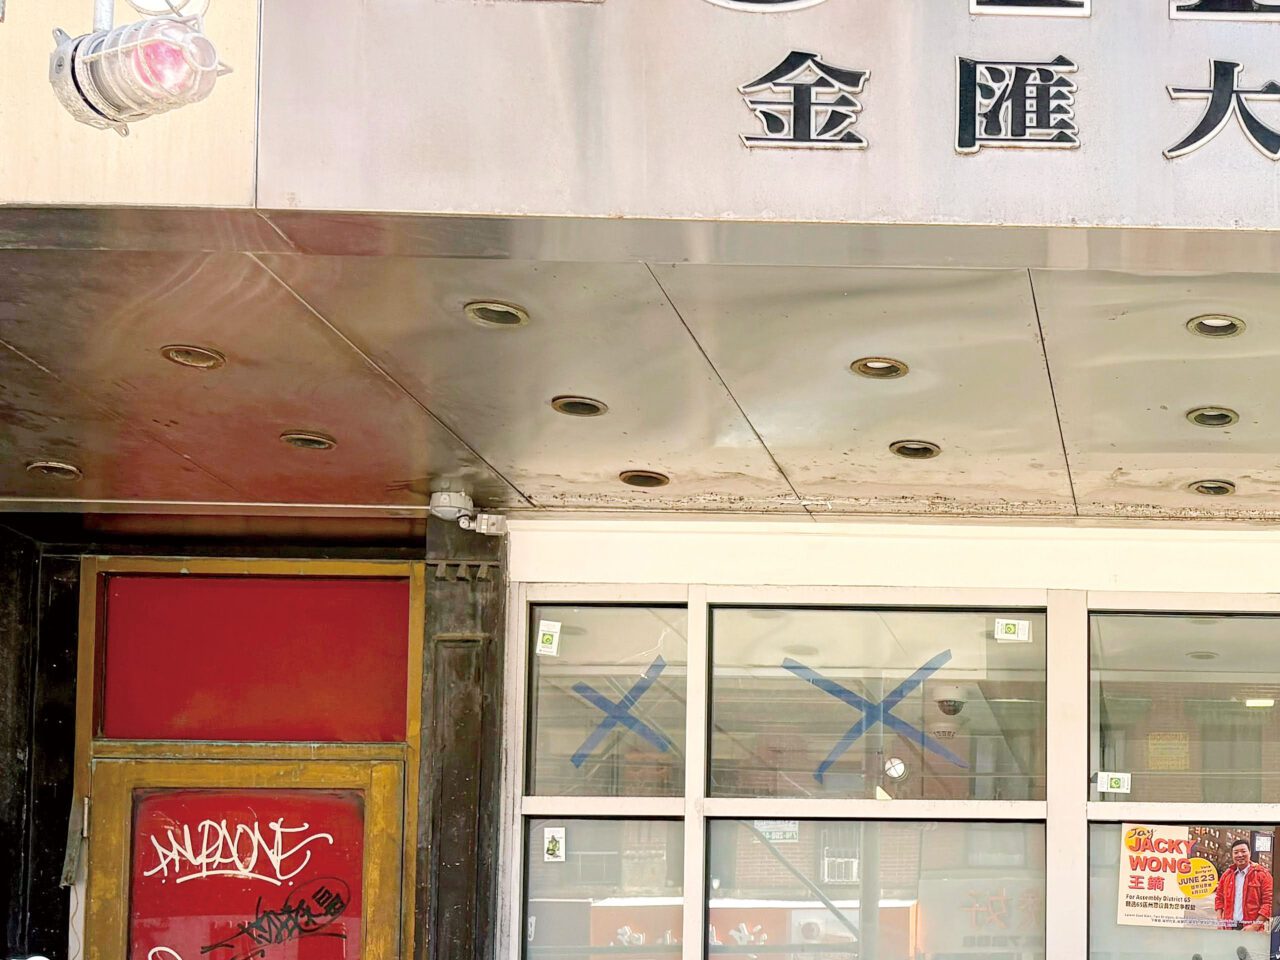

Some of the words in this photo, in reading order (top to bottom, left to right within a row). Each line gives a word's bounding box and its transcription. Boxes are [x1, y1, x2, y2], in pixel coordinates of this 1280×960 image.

[1128, 828, 1154, 840] Jay
[1128, 837, 1198, 855] JACKY
[1129, 855, 1192, 874] WONG
[1178, 876, 1199, 886] JUNE
[1200, 874, 1215, 882] 23
[1136, 894, 1162, 902] Assembly
[1163, 895, 1183, 903] District
